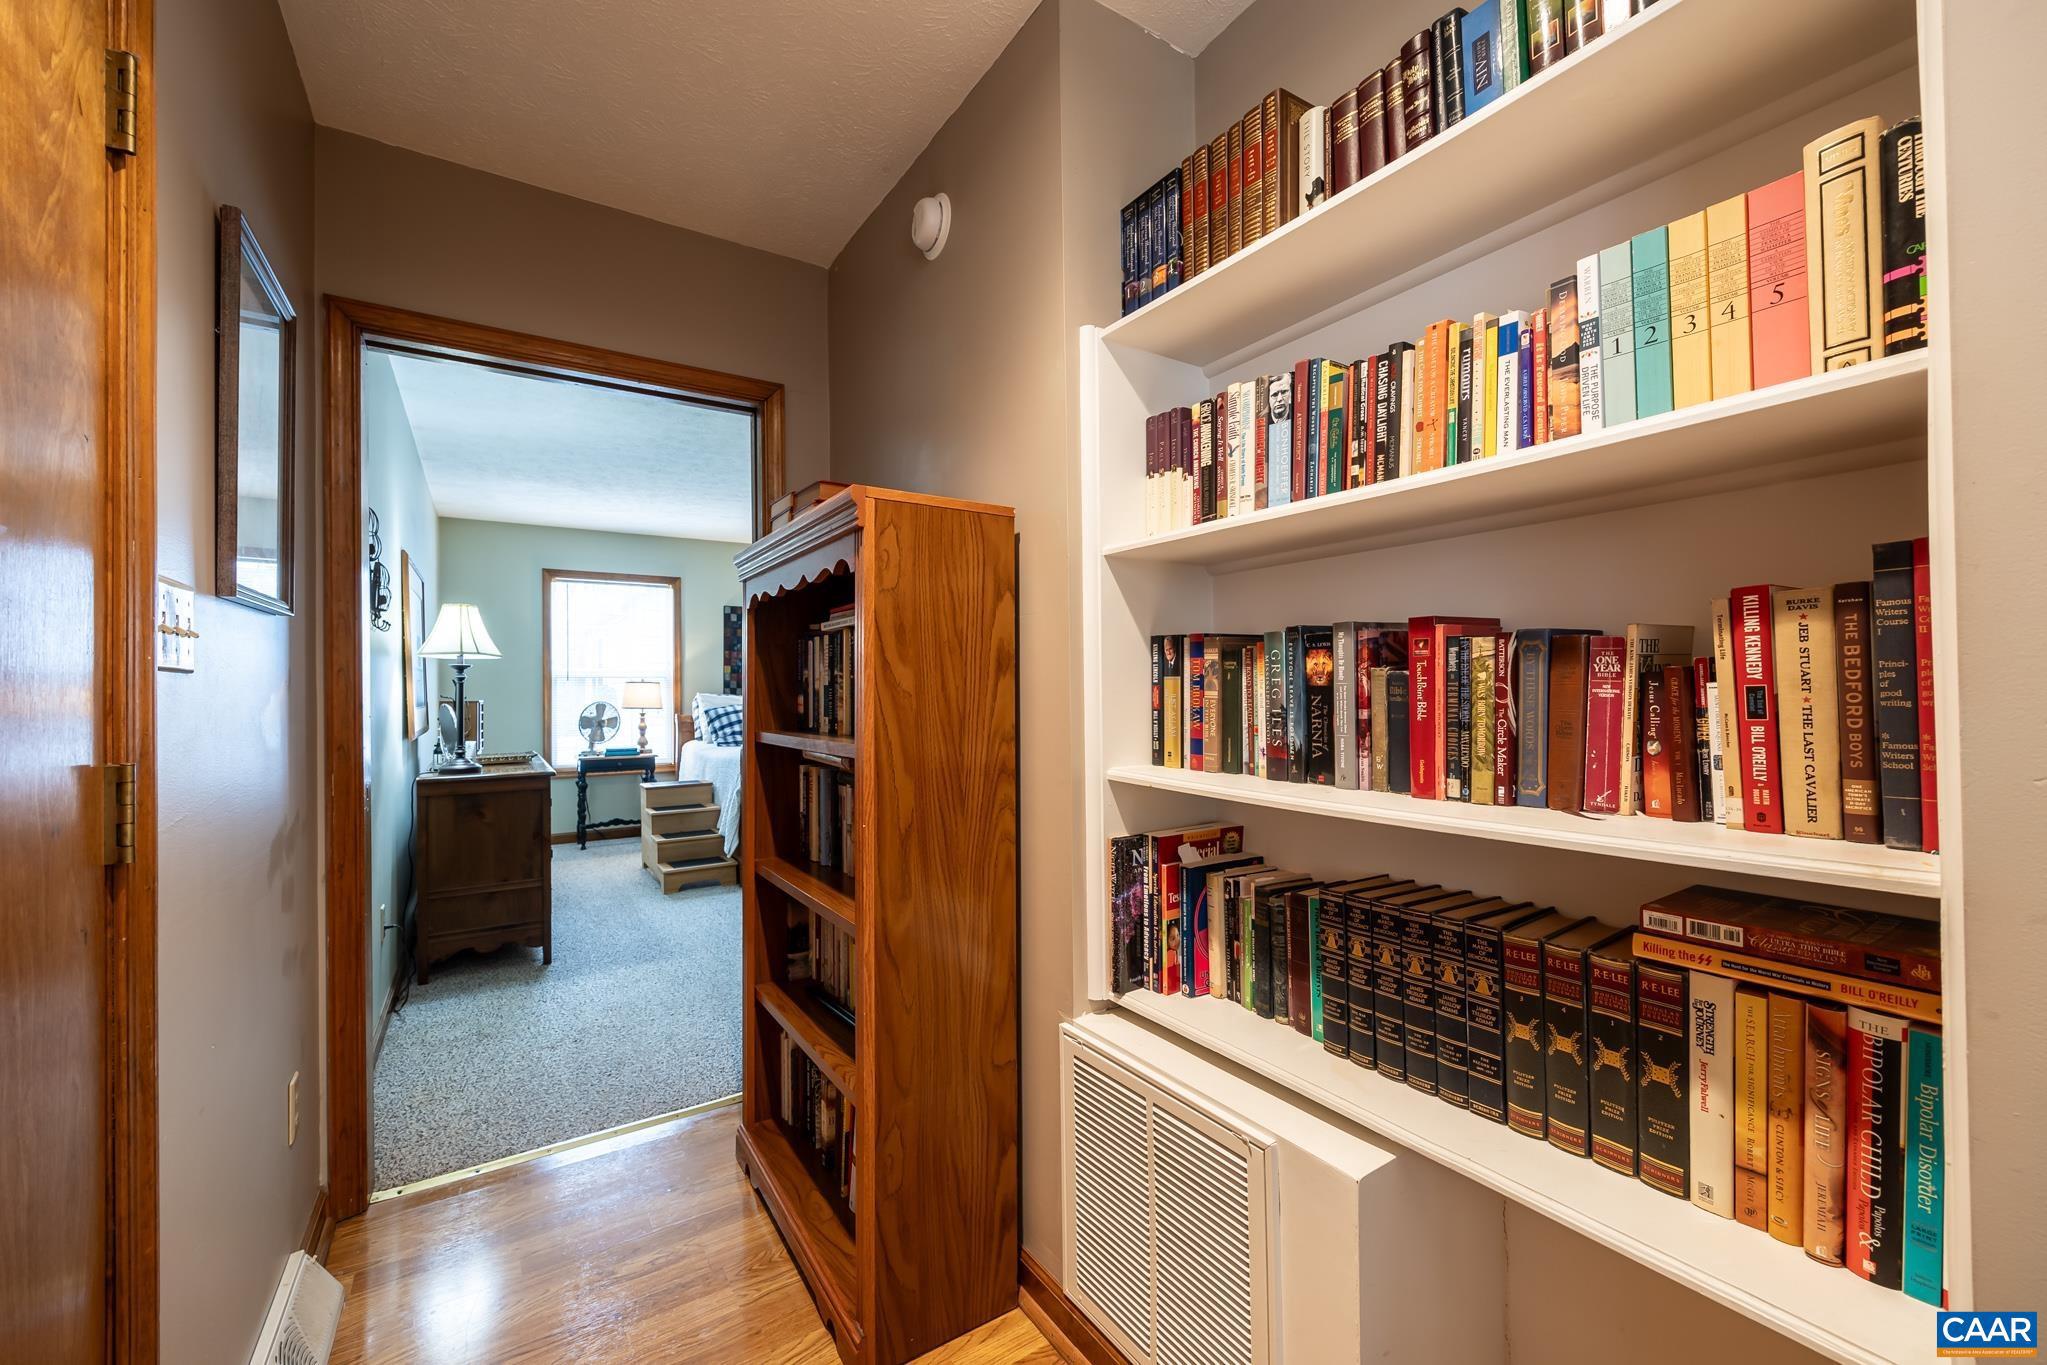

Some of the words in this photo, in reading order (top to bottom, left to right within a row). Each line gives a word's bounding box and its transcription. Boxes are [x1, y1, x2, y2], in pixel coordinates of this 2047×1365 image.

[1303, 120, 1312, 137] THE
[1303, 144, 1313, 178] STORY
[1897, 135, 1914, 203] CENTURIES
[1770, 282, 1785, 304] 5
[1721, 301, 1736, 320] 4
[1644, 325, 1659, 345] 2
[1683, 314, 1697, 334] 3
[1612, 337, 1622, 355] 1
[1378, 360, 1388, 399] CHASING
[1461, 347, 1471, 401] rumours
[1590, 364, 1598, 380] THE
[1200, 402, 1212, 424] GRACE
[1582, 400, 1590, 416] LIFE
[1591, 382, 1599, 421] PURPOSE
[1377, 403, 1387, 444] DAYLIGHT
[1201, 423, 1212, 467] AWAKENING
[1280, 422, 1289, 496] BONHOEFFER
[1741, 595, 1760, 633] KILLING
[1786, 597, 1820, 606] BURKE
[1787, 603, 1819, 611] DAVIS
[1875, 598, 1912, 608] Famous
[1875, 607, 1908, 616] Writers
[1716, 614, 1725, 646] Terminating
[1798, 623, 1809, 642] JEB
[1843, 612, 1857, 639] THE
[1876, 617, 1909, 627] Course
[1595, 656, 1619, 665] ONE
[1719, 646, 1727, 660] Life
[1743, 635, 1763, 680] KENNEDY
[1879, 660, 1909, 670] Princi-
[1192, 659, 1200, 681] TOM
[1270, 649, 1281, 699] GREG
[1337, 666, 1345, 681] Bloody
[1416, 660, 1427, 701] TouchPoint
[1593, 664, 1621, 673] YEAR
[1799, 647, 1811, 694] STUART
[1879, 669, 1896, 679] ples
[1477, 682, 1486, 697] WAS
[1648, 680, 1659, 703] Jesus
[1844, 644, 1863, 730] BEDFORD
[1880, 689, 1903, 698] good
[1192, 685, 1200, 730] BROKAW
[1416, 701, 1427, 721] Bible
[1447, 682, 1458, 722] TERMINAL
[1477, 700, 1486, 717] BORN
[1880, 698, 1912, 709] writing
[1289, 711, 1294, 719] IS
[1311, 695, 1322, 759] NARNIA
[1647, 705, 1661, 737] Calling
[1802, 705, 1813, 730] THE
[1271, 709, 1282, 747] ILES
[1477, 719, 1486, 758] TOMORROW
[1497, 719, 1506, 744] Circle
[1750, 725, 1765, 744] BILL
[1447, 727, 1458, 761] CHOICES
[1803, 732, 1815, 761] LAST
[1848, 733, 1863, 768] BOYS
[1882, 741, 1918, 750] Famous
[1882, 751, 1915, 761] Writers
[1497, 747, 1506, 776] Maker
[1751, 746, 1768, 782] O'REILLY
[1882, 761, 1915, 770] School
[1804, 764, 1817, 824] CAVALIER
[1472, 943, 1493, 953] MARCH
[1477, 938, 1488, 946] THE
[1467, 952, 1498, 964] DEMOCRACY
[1840, 983, 1864, 997] BILL
[1868, 990, 1919, 1009] O'REILLY
[1692, 1005, 1704, 1054] JOURNEY
[1702, 1000, 1716, 1056] STRENGTH
[1745, 1018, 1756, 1061] SEARCH
[1858, 1020, 1889, 1036] THE
[1772, 1009, 1793, 1099] Attachments
[1513, 1069, 1535, 1079] PULITZER
[1516, 1075, 1531, 1083] PRIZE
[1698, 1059, 1708, 1083] Jerry
[1814, 1049, 1831, 1100] SIGNS
[1861, 1033, 1884, 1122] BIPOLAR
[1513, 1079, 1534, 1089] EDITION
[1554, 1094, 1576, 1105] EDITION
[1700, 1083, 1709, 1113] Falwell
[1747, 1076, 1755, 1134] SIGNIFICANCE
[1914, 1083, 1938, 1138] Bipolar
[1510, 1112, 1540, 1127] SCRIBNERS
[1775, 1124, 1785, 1165] CLINTON
[1815, 1114, 1831, 1152] LIFE
[1746, 1137, 1755, 1167] ROBERT
[1860, 1130, 1882, 1200] CHILD
[1775, 1175, 1784, 1203] SIBCY
[1917, 1143, 1937, 1213] Disorder
[1816, 1181, 1827, 1232] JEREMIAH
[1873, 1205, 1886, 1237] Papolos
[1858, 1232, 1881, 1252] &
